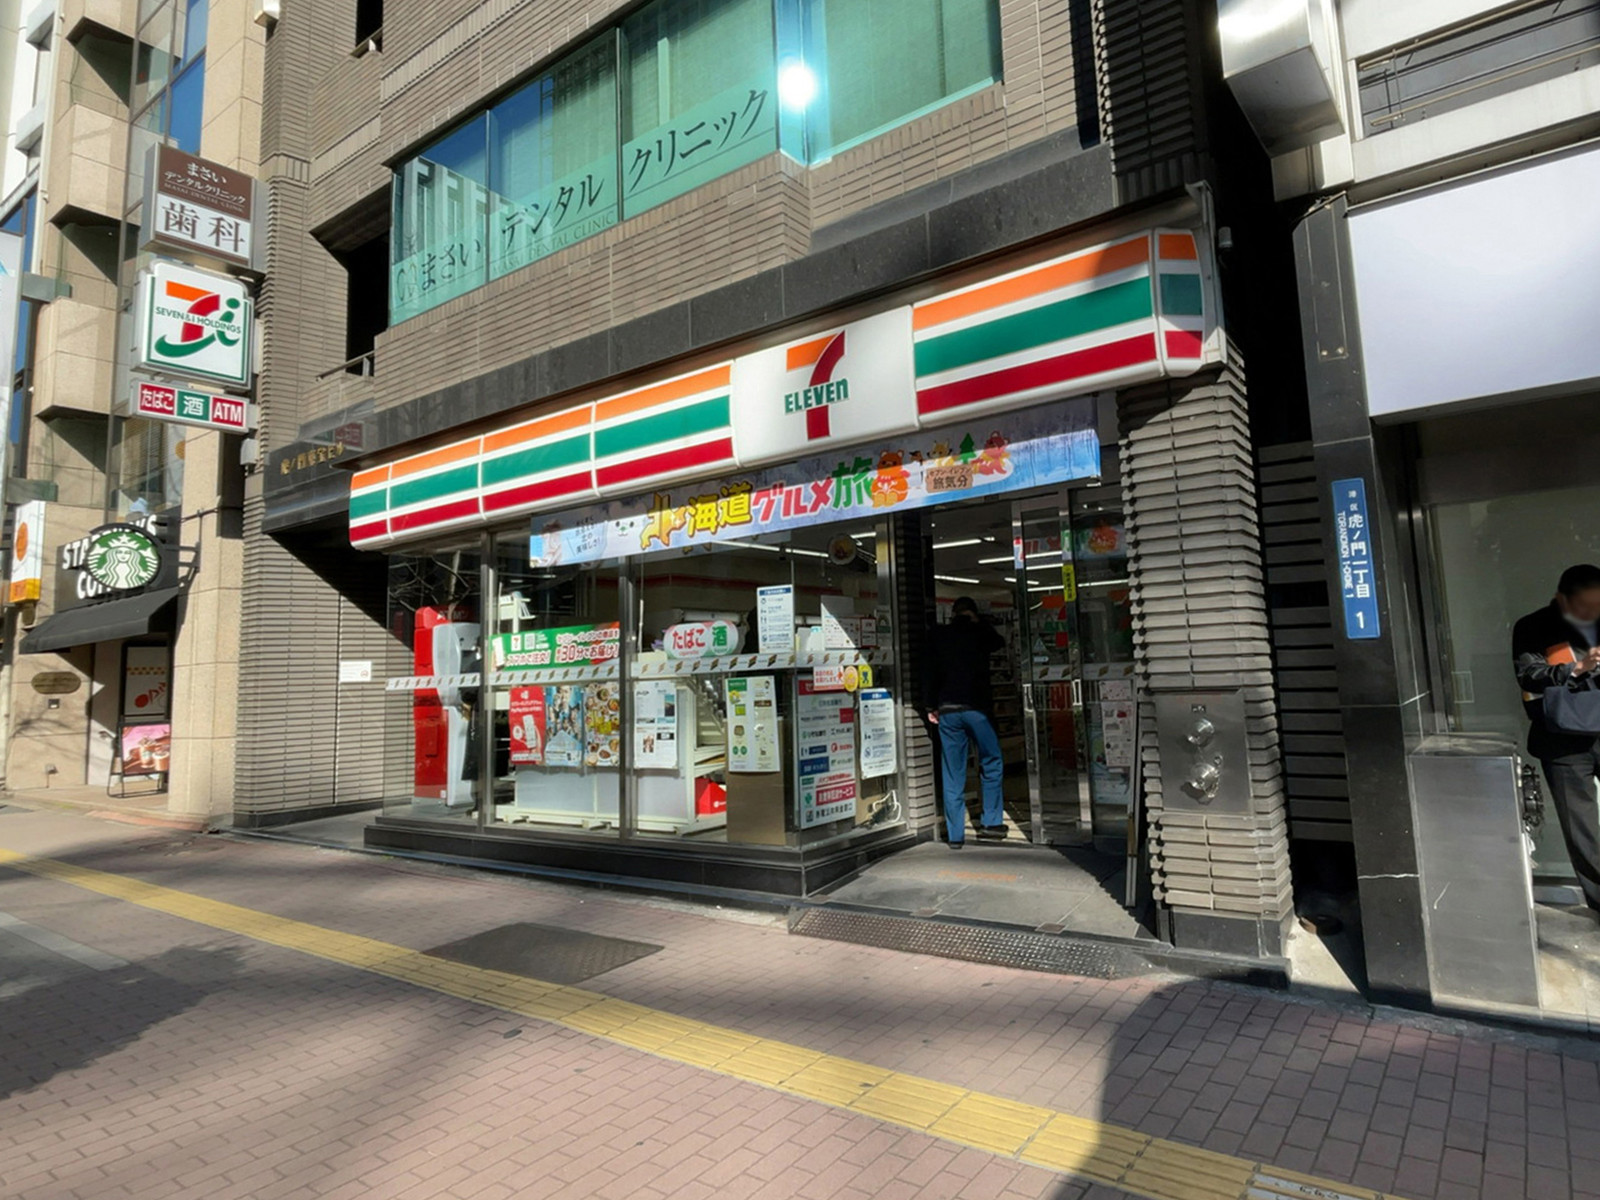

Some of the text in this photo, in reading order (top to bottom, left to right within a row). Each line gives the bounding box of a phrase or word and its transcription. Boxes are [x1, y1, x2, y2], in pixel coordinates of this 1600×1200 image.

[628, 89, 768, 193] クリニック
[187, 162, 227, 183] まさい
[164, 170, 246, 204] デンタルクリニック
[162, 200, 245, 252] 歯科
[421, 172, 605, 292] まさい デンタル
[573, 209, 615, 241] CLINIC
[197, 317, 242, 335] HOLDINGS
[141, 388, 174, 411] たばこ
[183, 394, 206, 417] 酒
[213, 401, 243, 424] ATM
[933, 475, 969, 490] 旅気分
[1348, 513, 1370, 598] 虎ノ門一丁目
[1355, 610, 1364, 629] 1
[672, 628, 706, 650] たばこ
[712, 625, 728, 647] 酒
